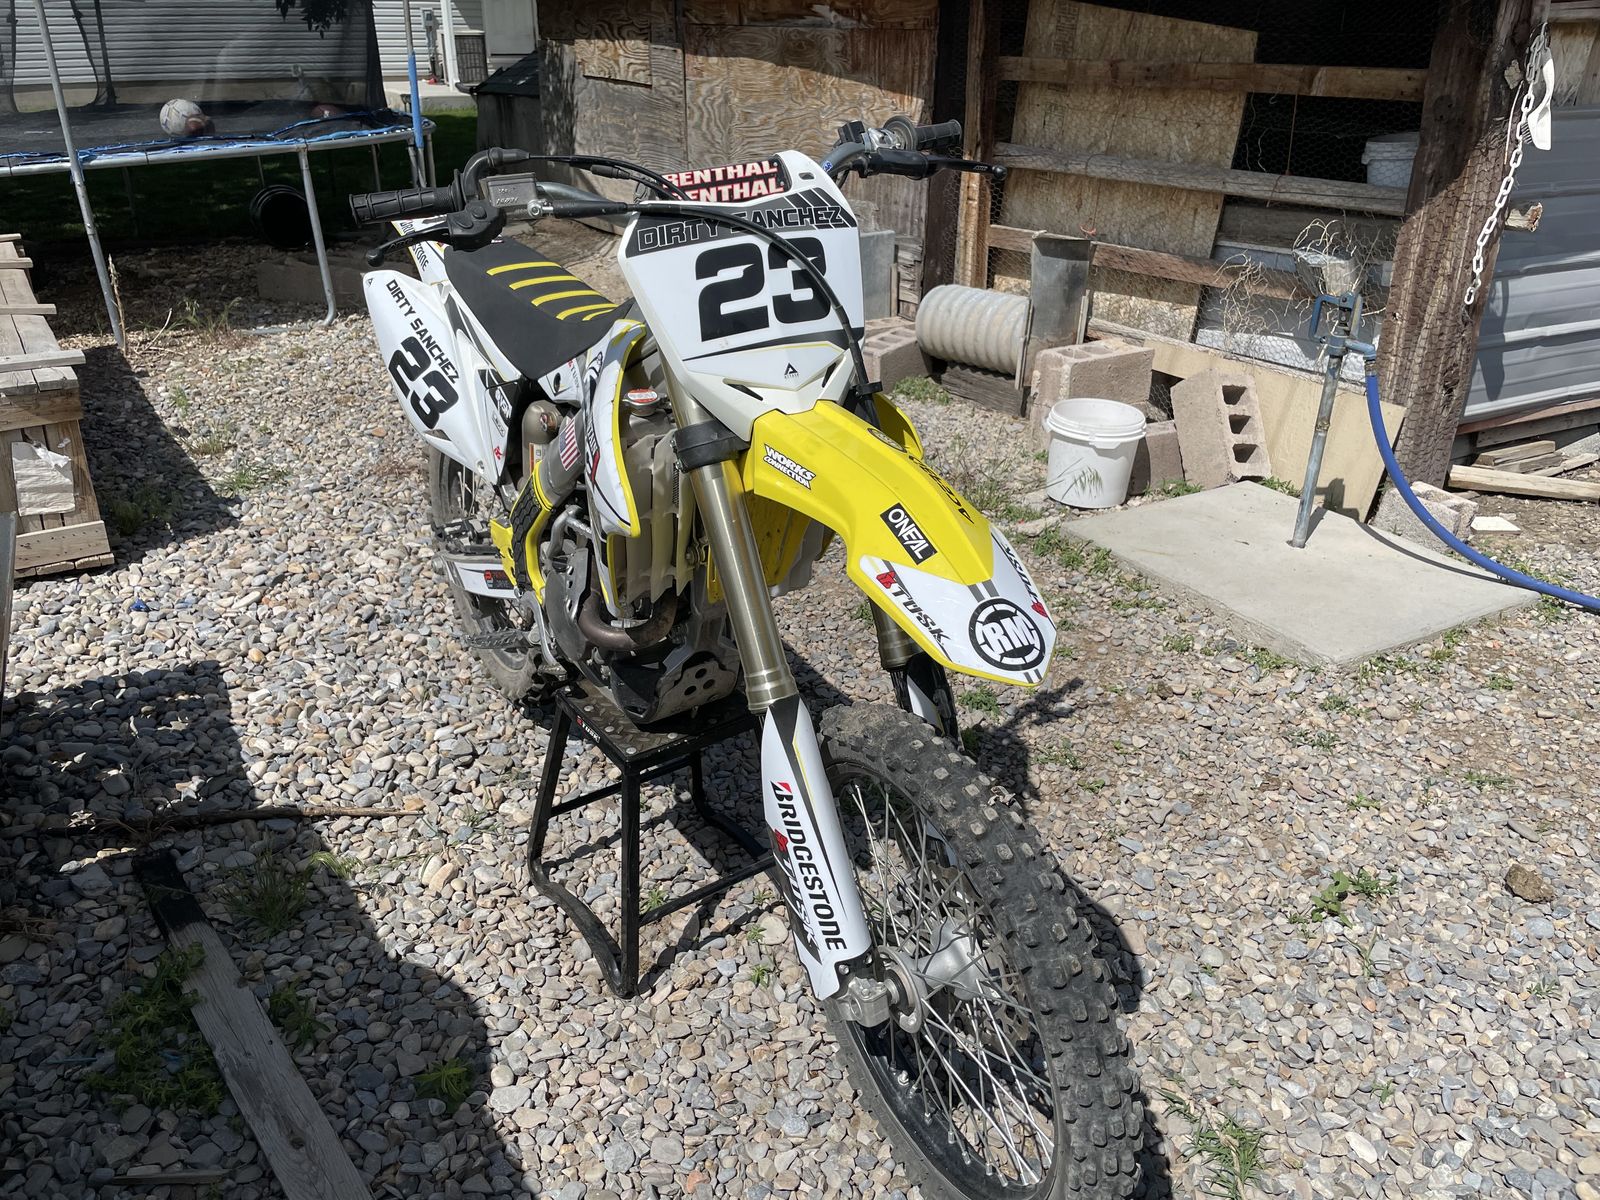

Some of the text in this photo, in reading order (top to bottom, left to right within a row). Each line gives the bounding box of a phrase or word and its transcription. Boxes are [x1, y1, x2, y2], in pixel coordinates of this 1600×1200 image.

[672, 177, 785, 203] ENTHAL
[638, 217, 720, 252] DIRTY
[695, 236, 832, 342] 23
[386, 279, 460, 384] DIRTY SANCHEZ
[388, 336, 459, 429] 23
[764, 444, 816, 481] WORKS
[890, 577, 953, 646] TUSK
[981, 612, 1036, 655] RM
[770, 780, 848, 951] BRIDGESTONE
